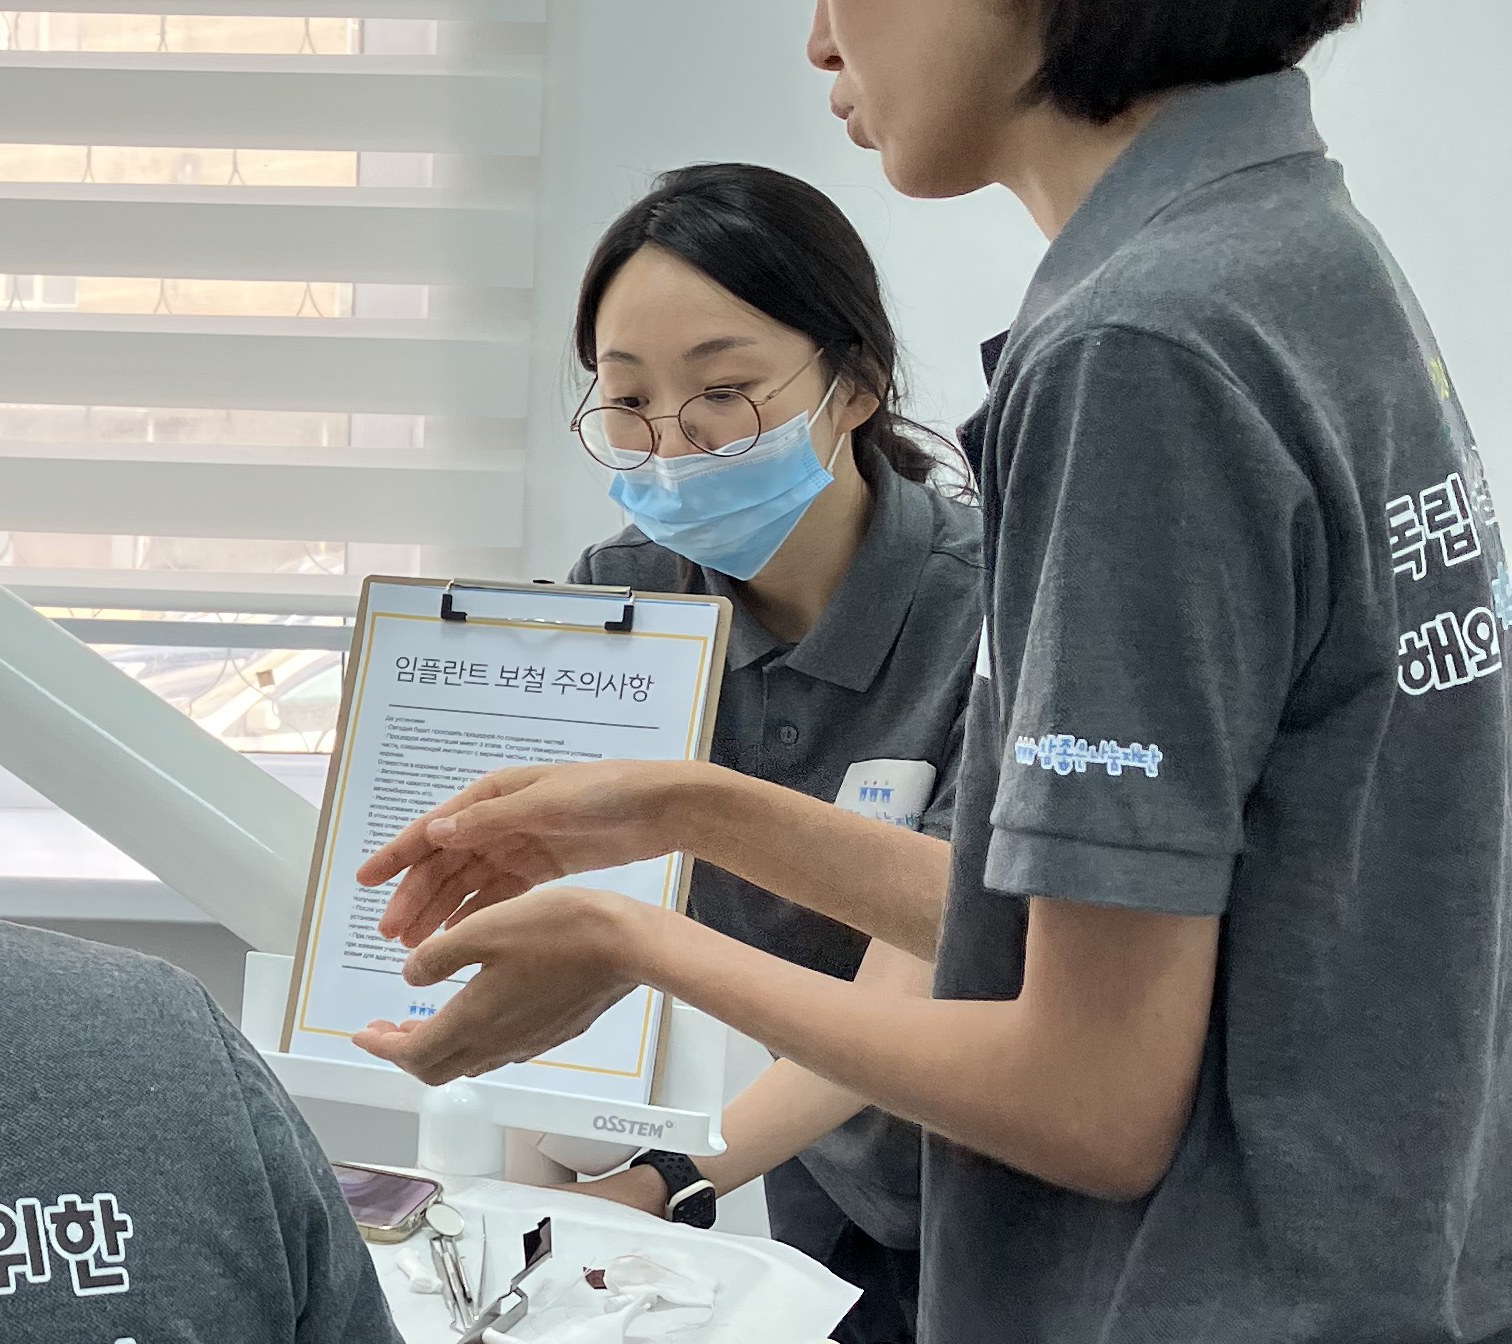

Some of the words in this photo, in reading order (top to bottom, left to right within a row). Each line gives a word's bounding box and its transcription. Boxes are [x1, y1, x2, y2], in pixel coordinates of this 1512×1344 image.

[395, 656, 489, 687] 임플란트
[494, 665, 546, 694] 보철
[551, 669, 656, 703] 주의사항
[592, 1115, 665, 1138] OSSTEM
